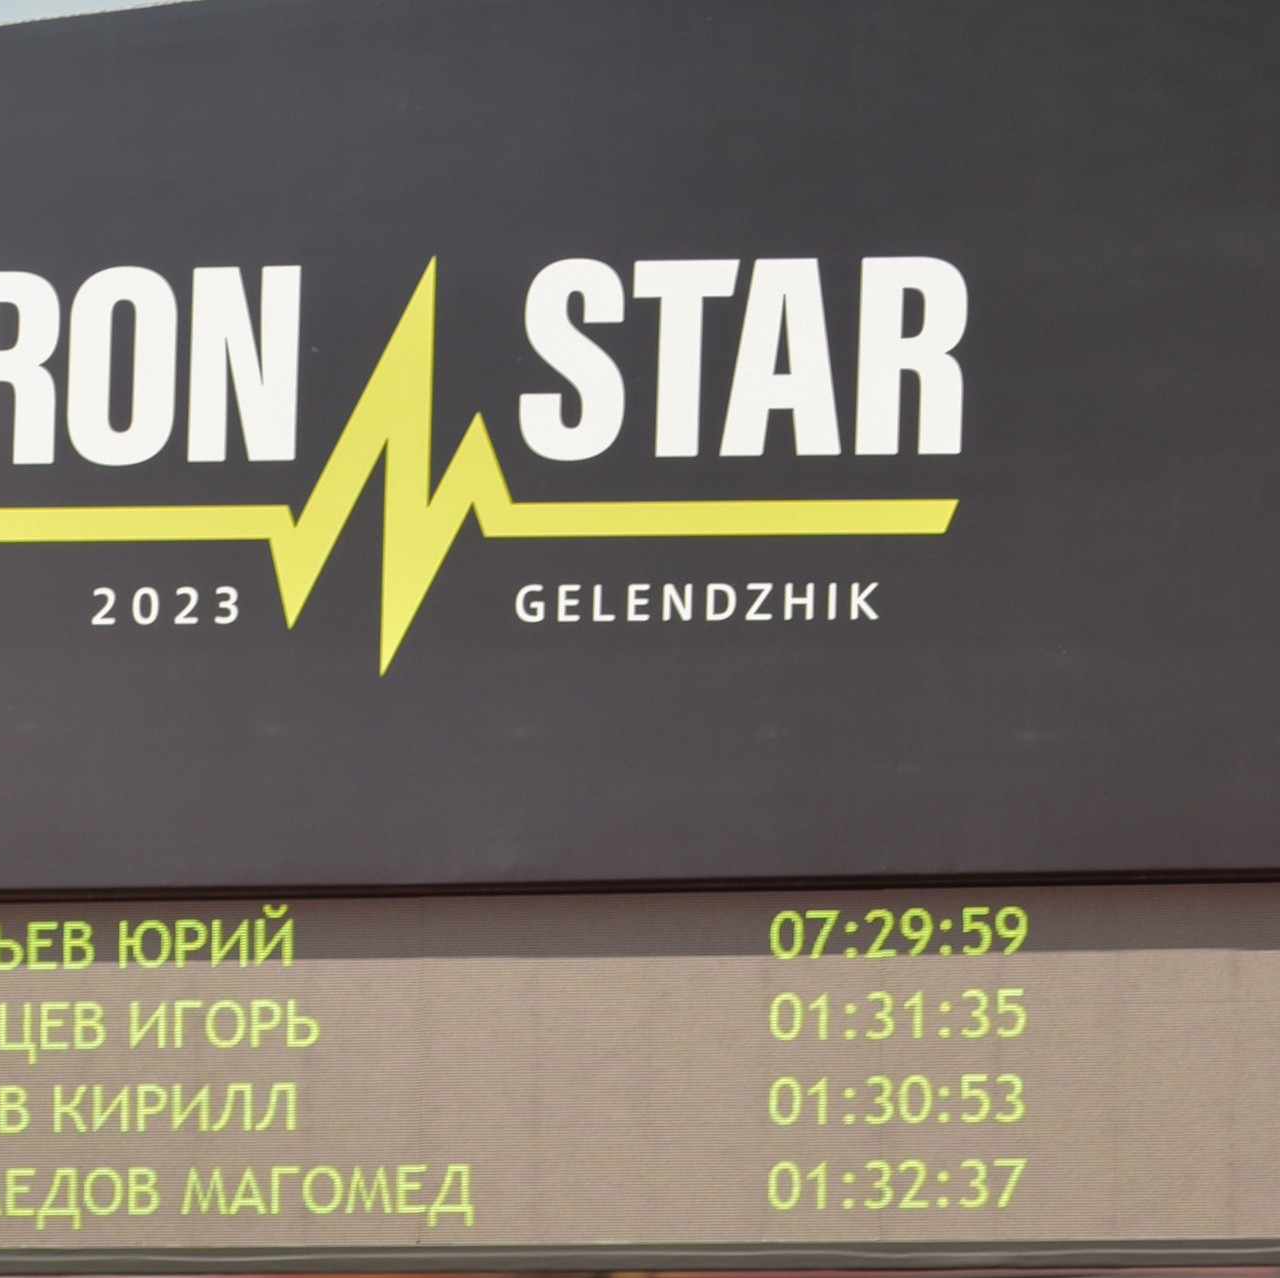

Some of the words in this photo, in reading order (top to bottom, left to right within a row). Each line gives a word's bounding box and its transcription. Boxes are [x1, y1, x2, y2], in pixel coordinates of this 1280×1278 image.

[519, 256, 969, 462] STAR
[89, 585, 241, 627] 2023
[513, 580, 882, 624] GELENDZHIK
[119, 903, 296, 968] ЮРИЙ
[769, 905, 1029, 960] 07:29:59
[129, 999, 321, 1049] ИГОРЬ
[768, 987, 1029, 1041] 01:31:35
[51, 1083, 298, 1133] КИРИЛЛ
[767, 1073, 1027, 1126] 01:30:53
[180, 1163, 475, 1226] МАГОМЕД
[767, 1158, 1028, 1210] 01:32:37
